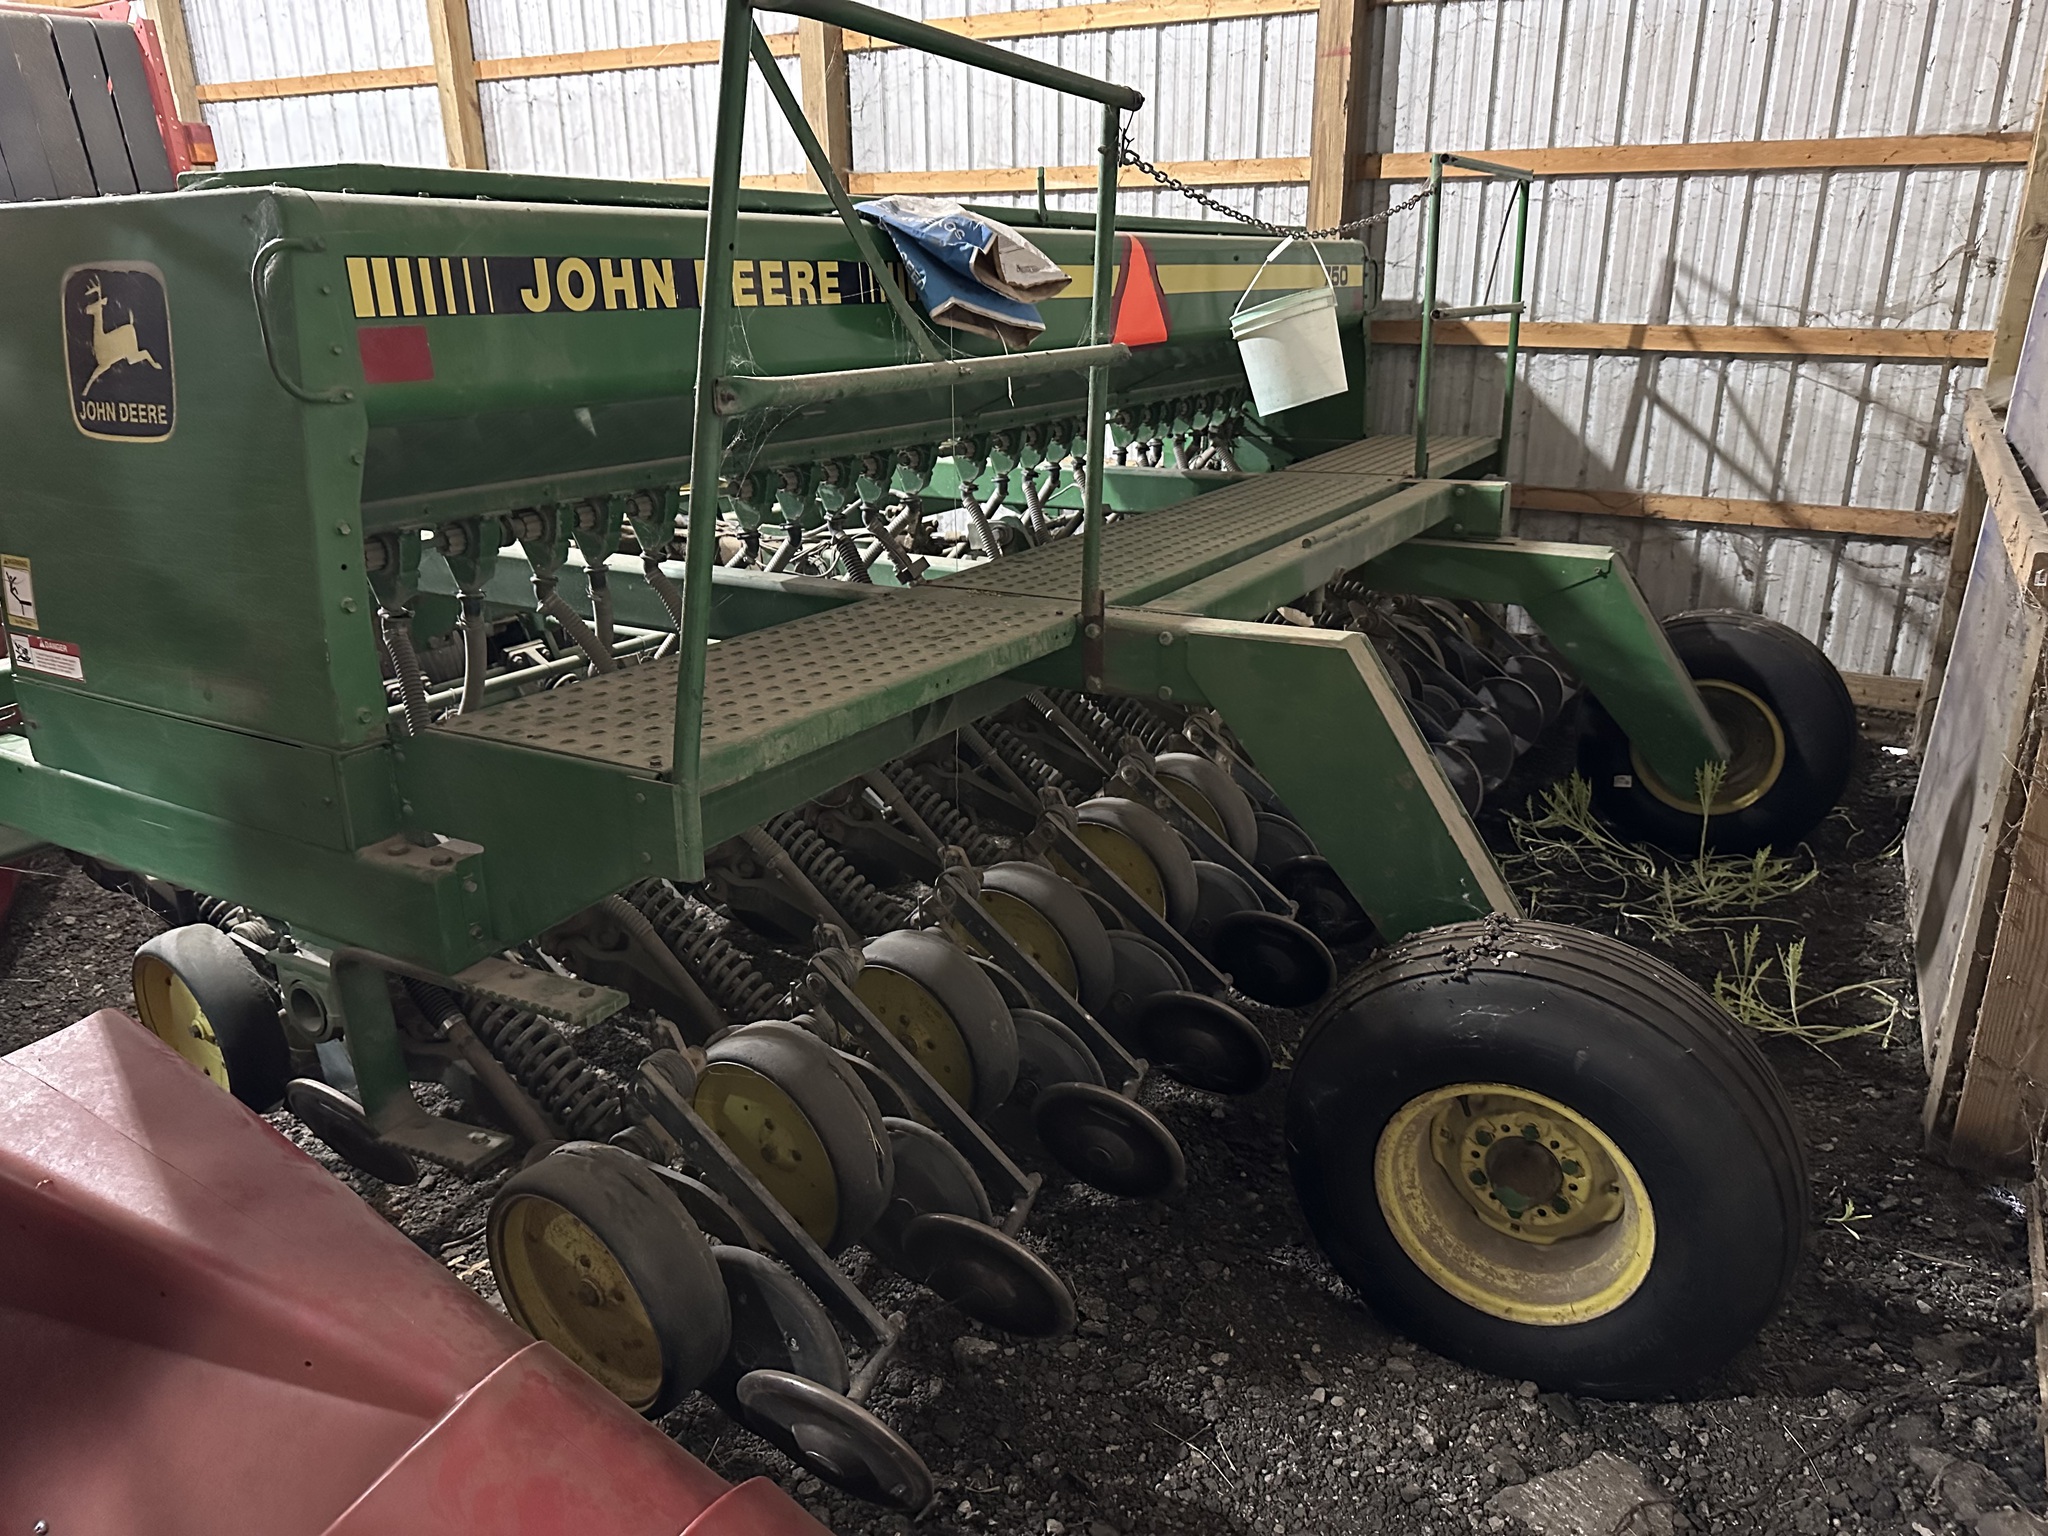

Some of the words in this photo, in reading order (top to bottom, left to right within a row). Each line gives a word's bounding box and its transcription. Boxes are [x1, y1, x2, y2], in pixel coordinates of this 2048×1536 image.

[520, 257, 678, 312] JOHN
[80, 401, 116, 422] JOHN
[119, 403, 168, 425] DEERE
[44, 640, 68, 653] DANGER
